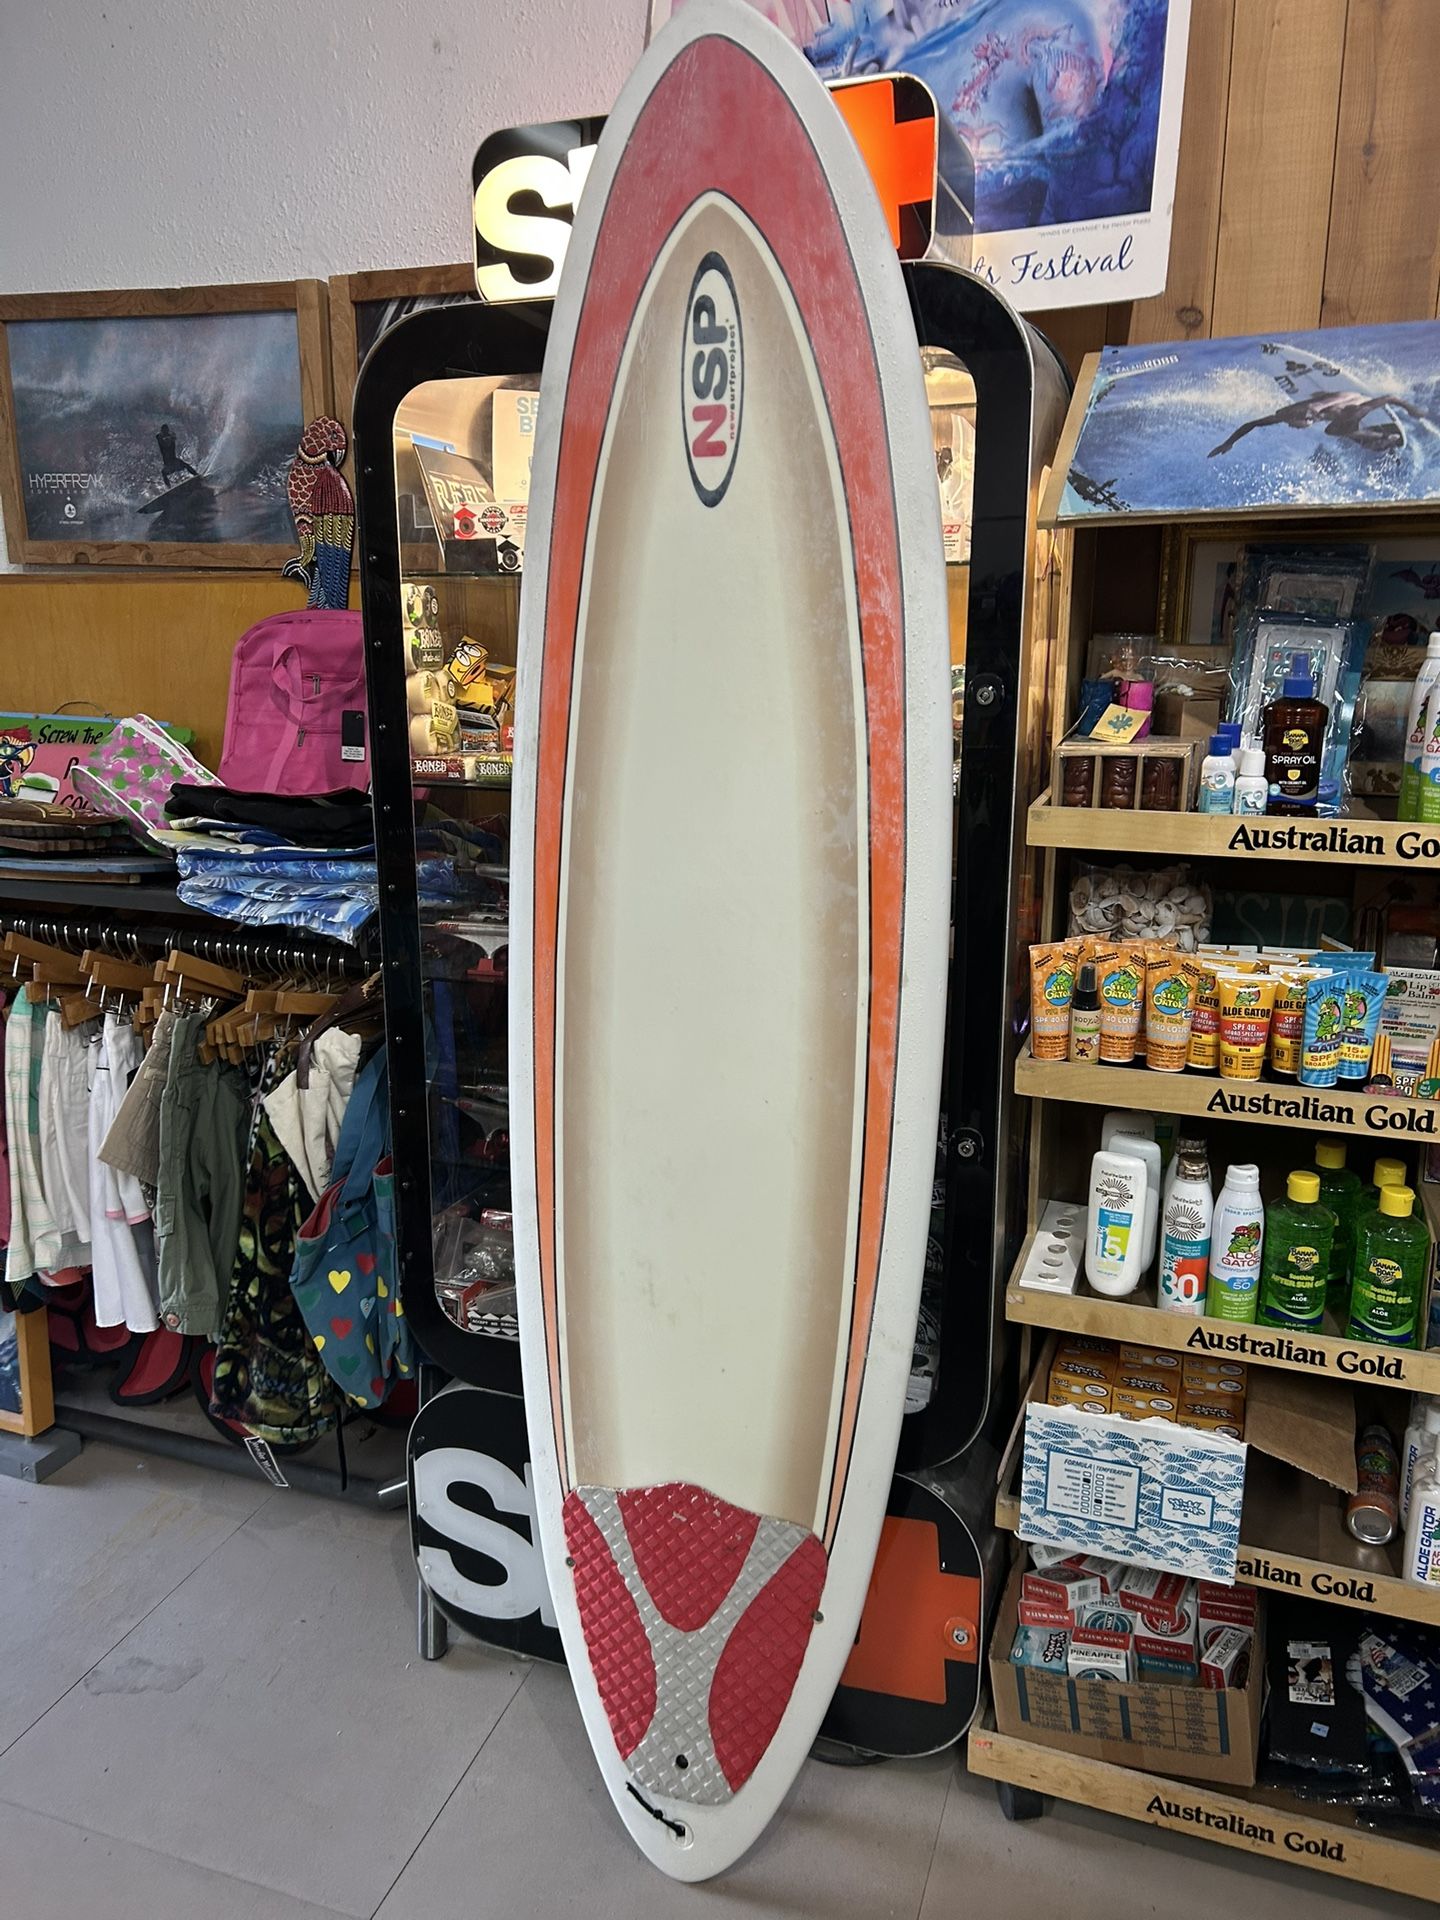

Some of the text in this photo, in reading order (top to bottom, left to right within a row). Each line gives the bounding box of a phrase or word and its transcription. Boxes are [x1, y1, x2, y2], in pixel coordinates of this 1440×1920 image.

[1011, 234, 1134, 285] Festival
[692, 294, 728, 458] NSP
[29, 473, 104, 489] HYPERFREAK
[38, 724, 78, 745] Screw
[414, 759, 447, 773] BONES
[1272, 754, 1317, 765] SPRAY OIL
[478, 762, 510, 775] BONES
[1228, 823, 1440, 860] Australian Go
[1408, 981, 1427, 992] Lip
[1407, 990, 1436, 1000] Balm
[1275, 999, 1294, 1010] ALOE
[1222, 1006, 1272, 1019] ALOE GATOR
[1232, 1022, 1245, 1031] SPF
[1310, 1054, 1332, 1063] SPF
[1395, 1076, 1416, 1086] SPF
[1206, 1088, 1435, 1134] Australian Gold
[1225, 1251, 1260, 1259] ALOE
[1289, 1247, 1318, 1258] BANANA
[1371, 1257, 1401, 1273] BANANA
[1161, 1269, 1199, 1303] 30
[1232, 1281, 1251, 1290] 50
[1296, 1280, 1314, 1289] SUN
[1377, 1294, 1413, 1305] SUN GEL
[1371, 1308, 1389, 1317] ALOE
[1186, 1326, 1404, 1380] Australian Gold
[1064, 1458, 1093, 1470] FORMULA
[1096, 1465, 1133, 1478] TEMPERATURE
[1416, 1505, 1437, 1581] ALOE GATOR
[1311, 1573, 1376, 1604] Gold
[1070, 1648, 1121, 1660] PINEAPPLE
[1211, 1631, 1239, 1666] PINEAPPLE
[1142, 1659, 1191, 1671] TROPIC WATER
[1146, 1795, 1345, 1863] Australian Gold
